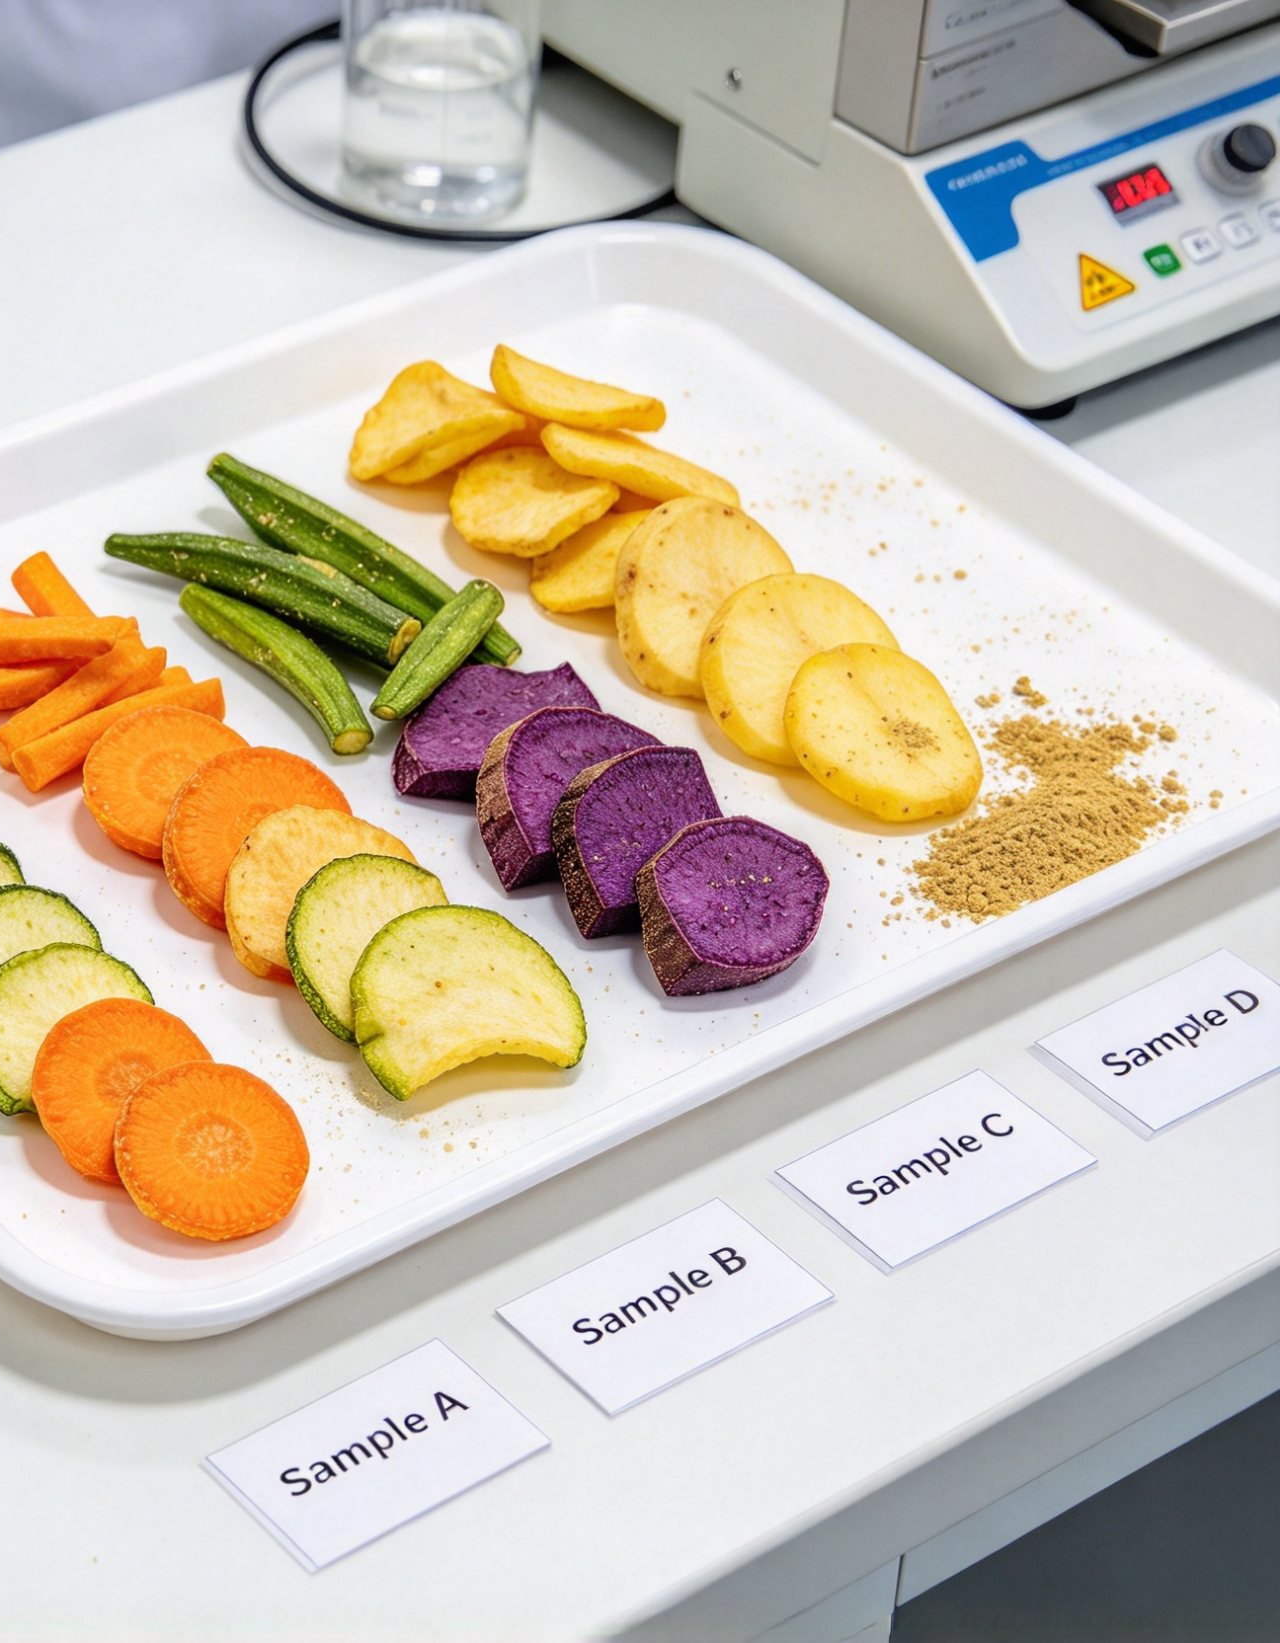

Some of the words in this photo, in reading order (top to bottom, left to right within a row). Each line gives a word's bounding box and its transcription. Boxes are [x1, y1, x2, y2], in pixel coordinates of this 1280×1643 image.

[1100, 1008, 1229, 1078] Sample
[1223, 989, 1260, 1016] D
[845, 1134, 984, 1207] Sample
[980, 1111, 1016, 1138] C
[571, 1268, 714, 1346] Sample
[707, 1246, 748, 1277] B
[279, 1411, 430, 1498] Sample
[432, 1390, 470, 1422] A
